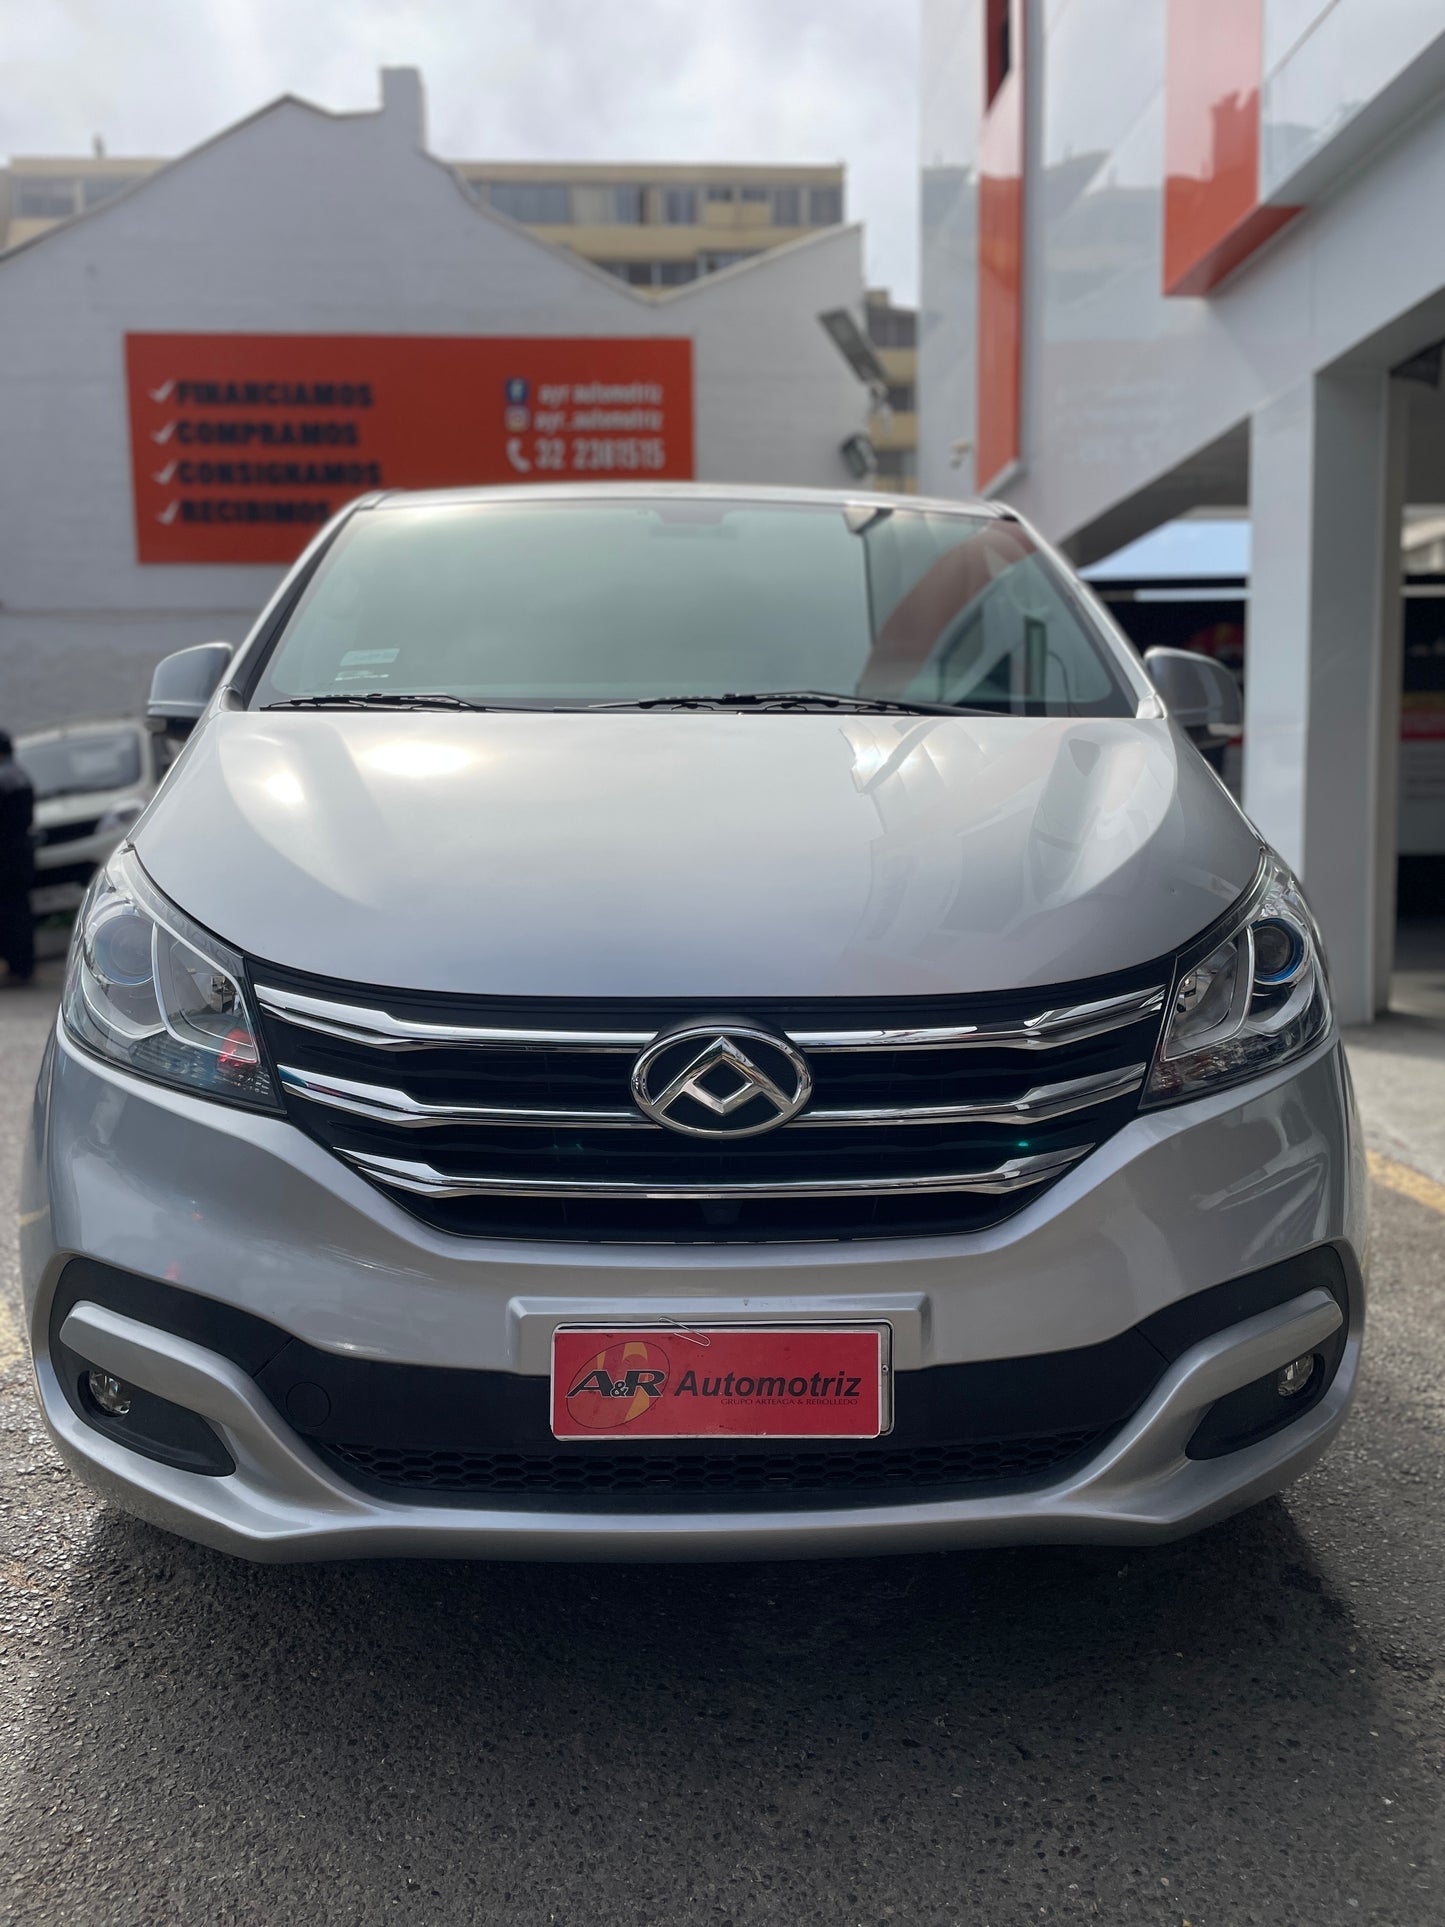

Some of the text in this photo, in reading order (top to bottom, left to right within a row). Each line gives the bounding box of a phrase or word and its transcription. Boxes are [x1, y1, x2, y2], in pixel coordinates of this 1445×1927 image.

[175, 380, 374, 407] FINANCIAMOS
[176, 421, 358, 446] COMPRAMOS
[177, 460, 381, 486] CONSIGNAMOS
[181, 500, 331, 525] RECIBIMOS
[565, 1369, 862, 1398] A&R Automotriz
[720, 1398, 754, 1406] GRUPO
